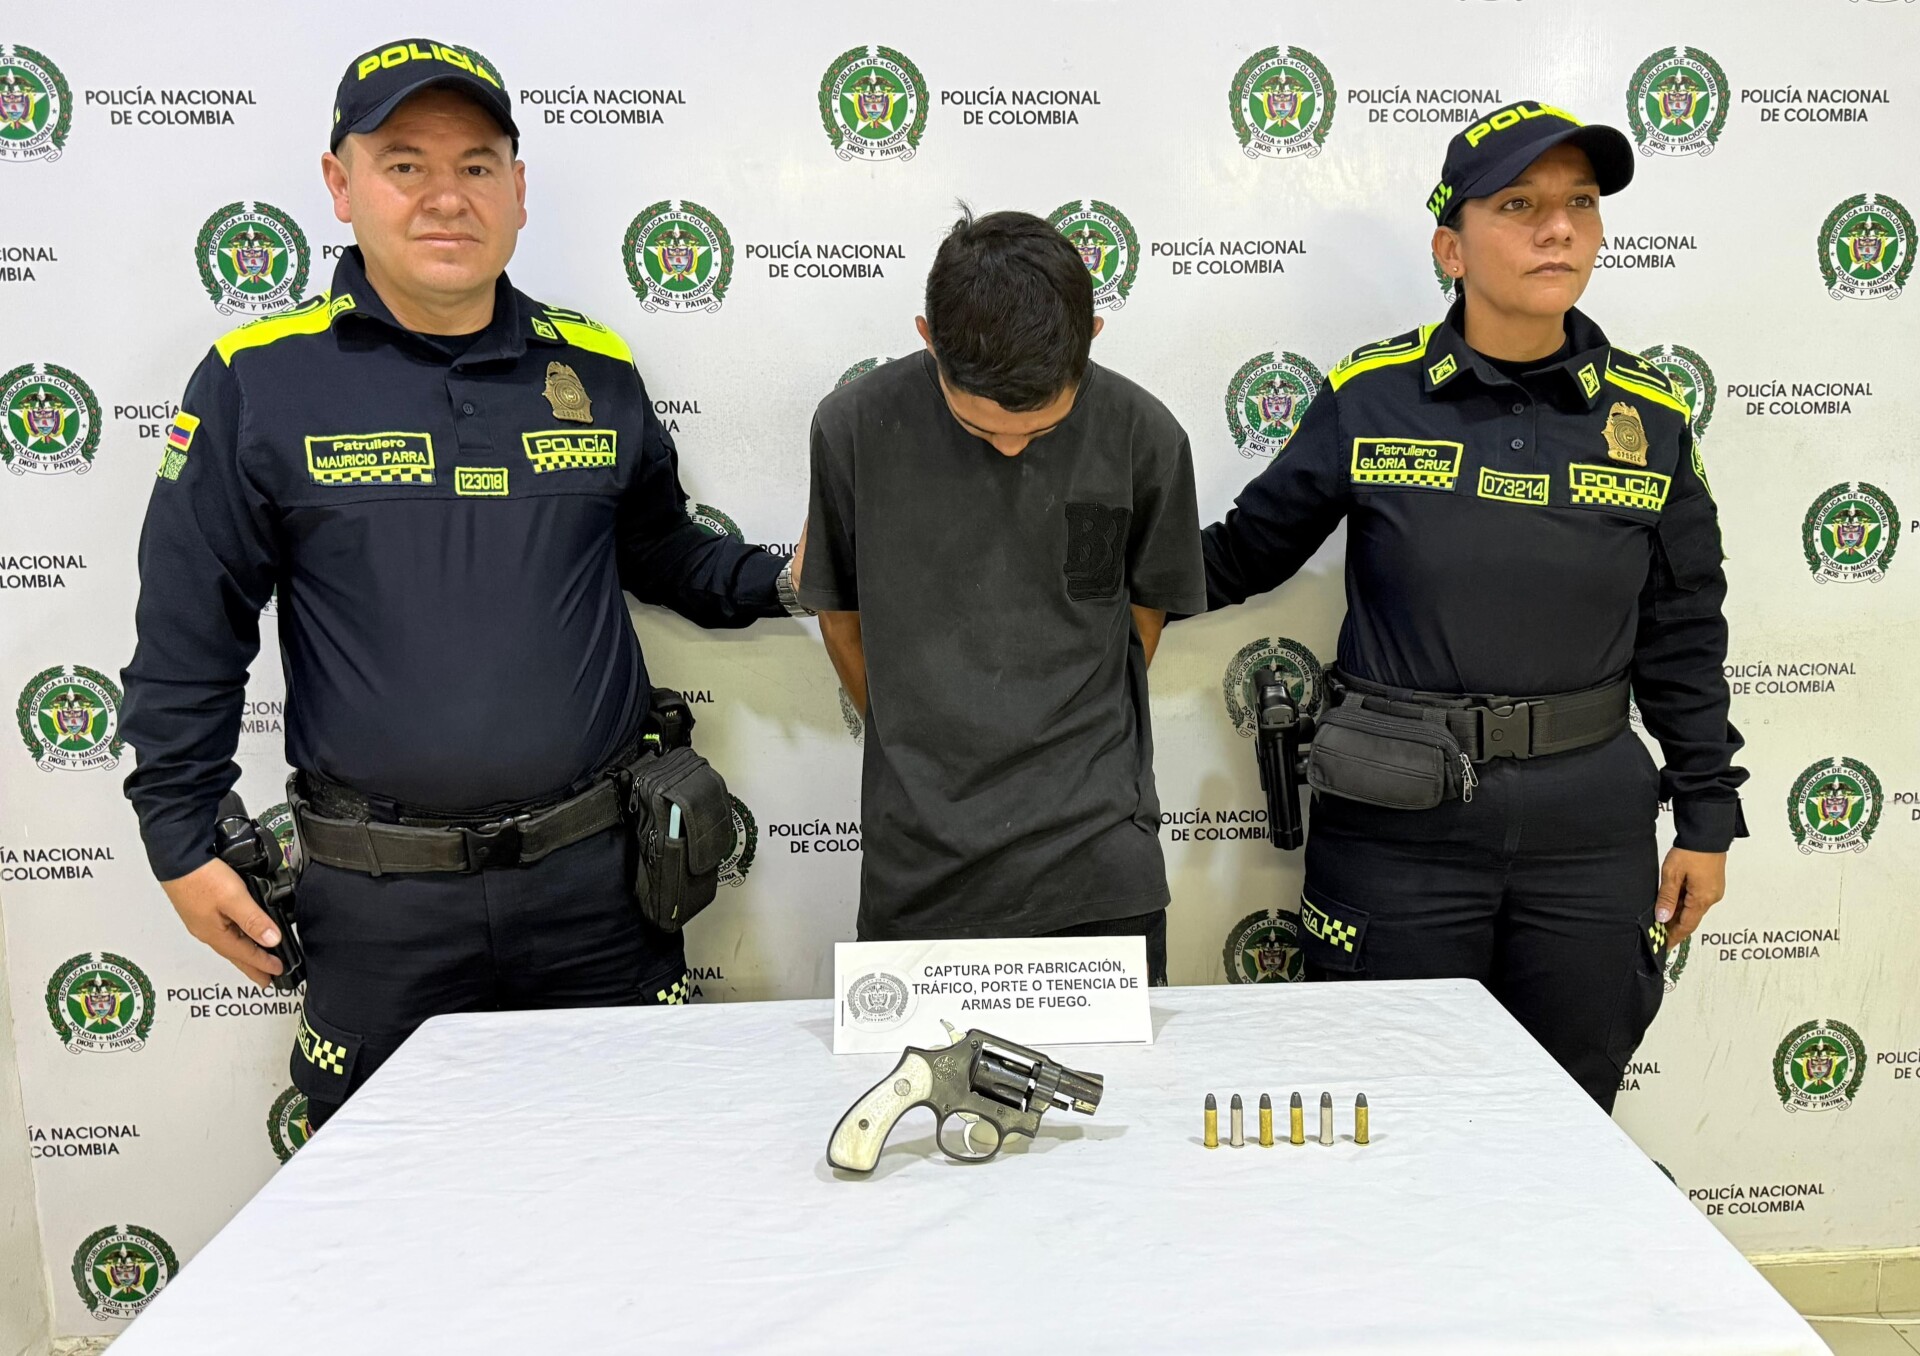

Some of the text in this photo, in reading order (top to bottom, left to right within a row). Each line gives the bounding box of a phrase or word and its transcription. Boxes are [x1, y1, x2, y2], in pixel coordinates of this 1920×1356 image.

[832, 62, 861, 100] REPUBLICA
[885, 61, 915, 100] COLOMBIA
[85, 85, 257, 106] POLICÍA NACIONAL
[520, 84, 687, 105] POLICÍA NACIONAL
[941, 85, 1101, 106] POLICÍA NACIONAL
[1347, 84, 1503, 104] POLICÍA NACIONAL
[1741, 84, 1890, 104] POLICÍA NACIONAL
[110, 109, 235, 126] DE COLOMBIA
[543, 109, 665, 126] DE COLOMBIA
[963, 110, 1079, 125] DE COLOMBIA
[1368, 107, 1480, 123] DE COLOMBIA
[1760, 107, 1869, 123] DE COLOMBIA
[840, 122, 911, 148] POLICIA NACIONAL
[846, 143, 865, 155] DIOS
[880, 144, 907, 157] PATRIA
[1830, 209, 1858, 244] REPUBLICA
[1881, 208, 1905, 243] COLOMBIA
[209, 218, 238, 256] REPUBLICA
[263, 217, 295, 254] COLOMBIA
[636, 216, 664, 254] REPUBLICA
[689, 216, 719, 253] COLOMBIA
[1613, 235, 1698, 251] NACIONAL
[0, 246, 58, 262] IONAL
[745, 239, 906, 259] POLICÍA NACIONAL
[1151, 237, 1307, 257] POLICÍA NACIONAL
[768, 263, 885, 279] DE COLOMBIA
[1172, 259, 1285, 276] DE COLOMBIA
[1835, 264, 1900, 288] POLICIA NACIONAL
[219, 276, 293, 302] POLICIA NACIONAL
[645, 275, 716, 300] POLICIA NACIONAL
[1839, 284, 1855, 294] DIOS
[1868, 284, 1894, 296] PATRIA
[227, 298, 246, 309] DIOS
[262, 298, 290, 311] PATRIA
[651, 296, 670, 307] DIOS
[685, 296, 713, 309] PATRIA
[1727, 379, 1873, 398] POLICÍA NACIONAL
[1746, 400, 1852, 416] DE COLOMBIA
[138, 424, 161, 439] DE
[333, 438, 406, 451] Patrullero
[535, 434, 611, 453] POLICÍA
[1375, 444, 1437, 458] Patrullero
[316, 451, 427, 469] MAURICIO PARRA
[1360, 457, 1451, 471] GLORIA CRUZ
[460, 473, 503, 490] 123018
[1483, 475, 1544, 499] 073214
[1580, 471, 1659, 497] POLICÍA
[0, 573, 66, 589] LOMBIA
[1722, 660, 1857, 678] OLICÍA NACIONAL
[1732, 679, 1836, 695] DE COLOMBIA
[31, 681, 57, 717] REPUBLICA
[81, 679, 113, 713] COLOMBIA
[41, 734, 111, 759] POLICIA NACIONAL
[48, 756, 67, 766] DIOS
[82, 754, 109, 767] PATRIA
[1799, 771, 1826, 804] REPUBLICA
[1848, 770, 1871, 801] COLOMBIA
[1160, 807, 1268, 825] OLICÍA NACIO
[768, 818, 832, 838] POLICÍA
[1171, 828, 1190, 842] DE
[1804, 820, 1866, 842] POLICIA NACIONAL
[790, 840, 810, 854] DE
[1808, 840, 1823, 849] DIOS
[1836, 838, 1860, 850] PATRIA
[22, 846, 115, 863] NACIONAL
[1, 865, 94, 882] COLOMBIA
[1701, 928, 1840, 945] POLICÍA NACIONAL
[1720, 946, 1819, 961] DE COLOMBIA
[924, 958, 1126, 977] CAPTURA POR FABRICACIÓN,
[59, 967, 86, 1002] REPUBLICA
[110, 965, 141, 998] COLOMBIA
[166, 982, 233, 1002] POLICÍA
[912, 977, 1138, 996] TRÁFICO, PORTE O TENENCIA DE
[189, 1001, 303, 1018] DE COLOMBIA
[961, 995, 1091, 1011] ARMAS DE FUEGO.
[68, 1017, 139, 1041] POLICIA NACIONAL
[76, 1038, 94, 1048] DIOS
[109, 1036, 136, 1049] PATRIA
[1894, 1066, 1912, 1080] DE
[51, 1124, 141, 1141] NACIONAL
[30, 1142, 120, 1159] COLOMBIA
[1688, 1183, 1825, 1201] POLICÍA NACIONAL
[1706, 1199, 1805, 1216] DE COLOMBIA
